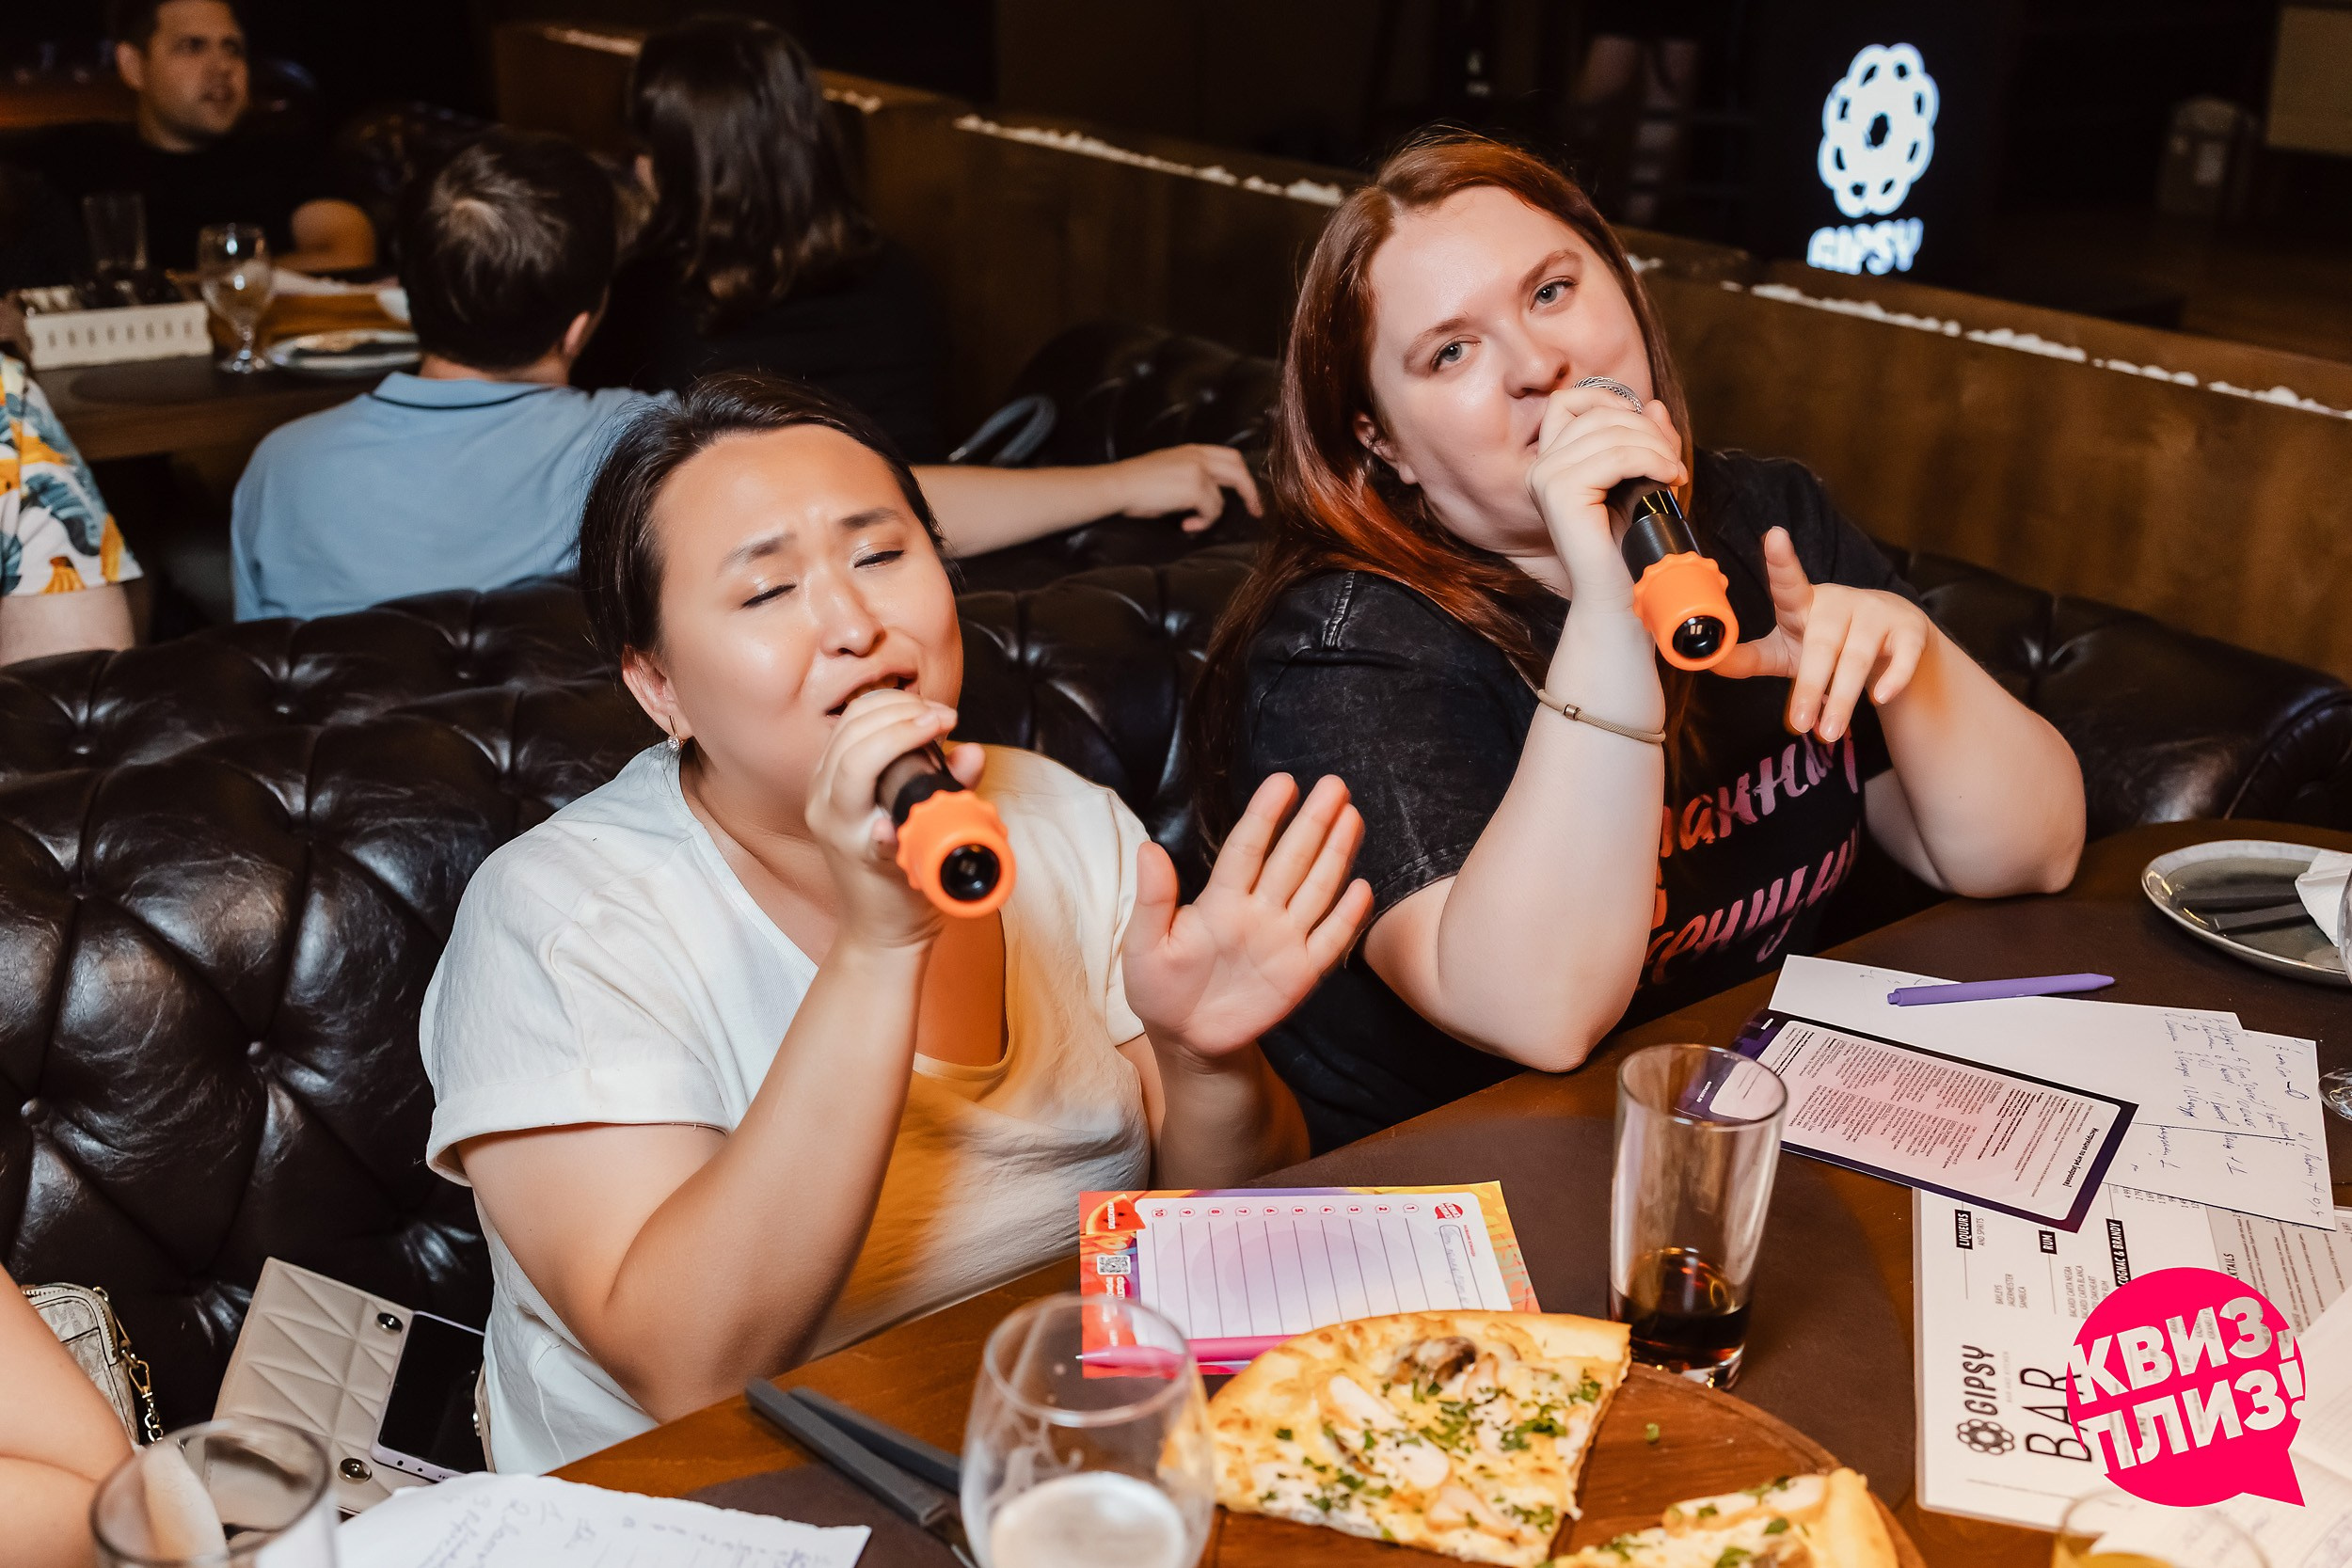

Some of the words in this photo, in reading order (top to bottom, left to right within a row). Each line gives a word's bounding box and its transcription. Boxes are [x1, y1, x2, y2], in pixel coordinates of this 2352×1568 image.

[1806, 217, 1924, 275] GIPSY
[1957, 1212, 1972, 1246] LIQUEURS
[1976, 1217, 1984, 1236] SPIRITS
[2109, 1221, 2122, 1250] BRANDY
[2042, 1234, 2053, 1250] RUM
[2113, 1258, 2129, 1285] COGNAC
[2066, 1281, 2075, 1296] CARTA
[1962, 1345, 1998, 1416] GIPSY
[2019, 1368, 2092, 1462] BAR
